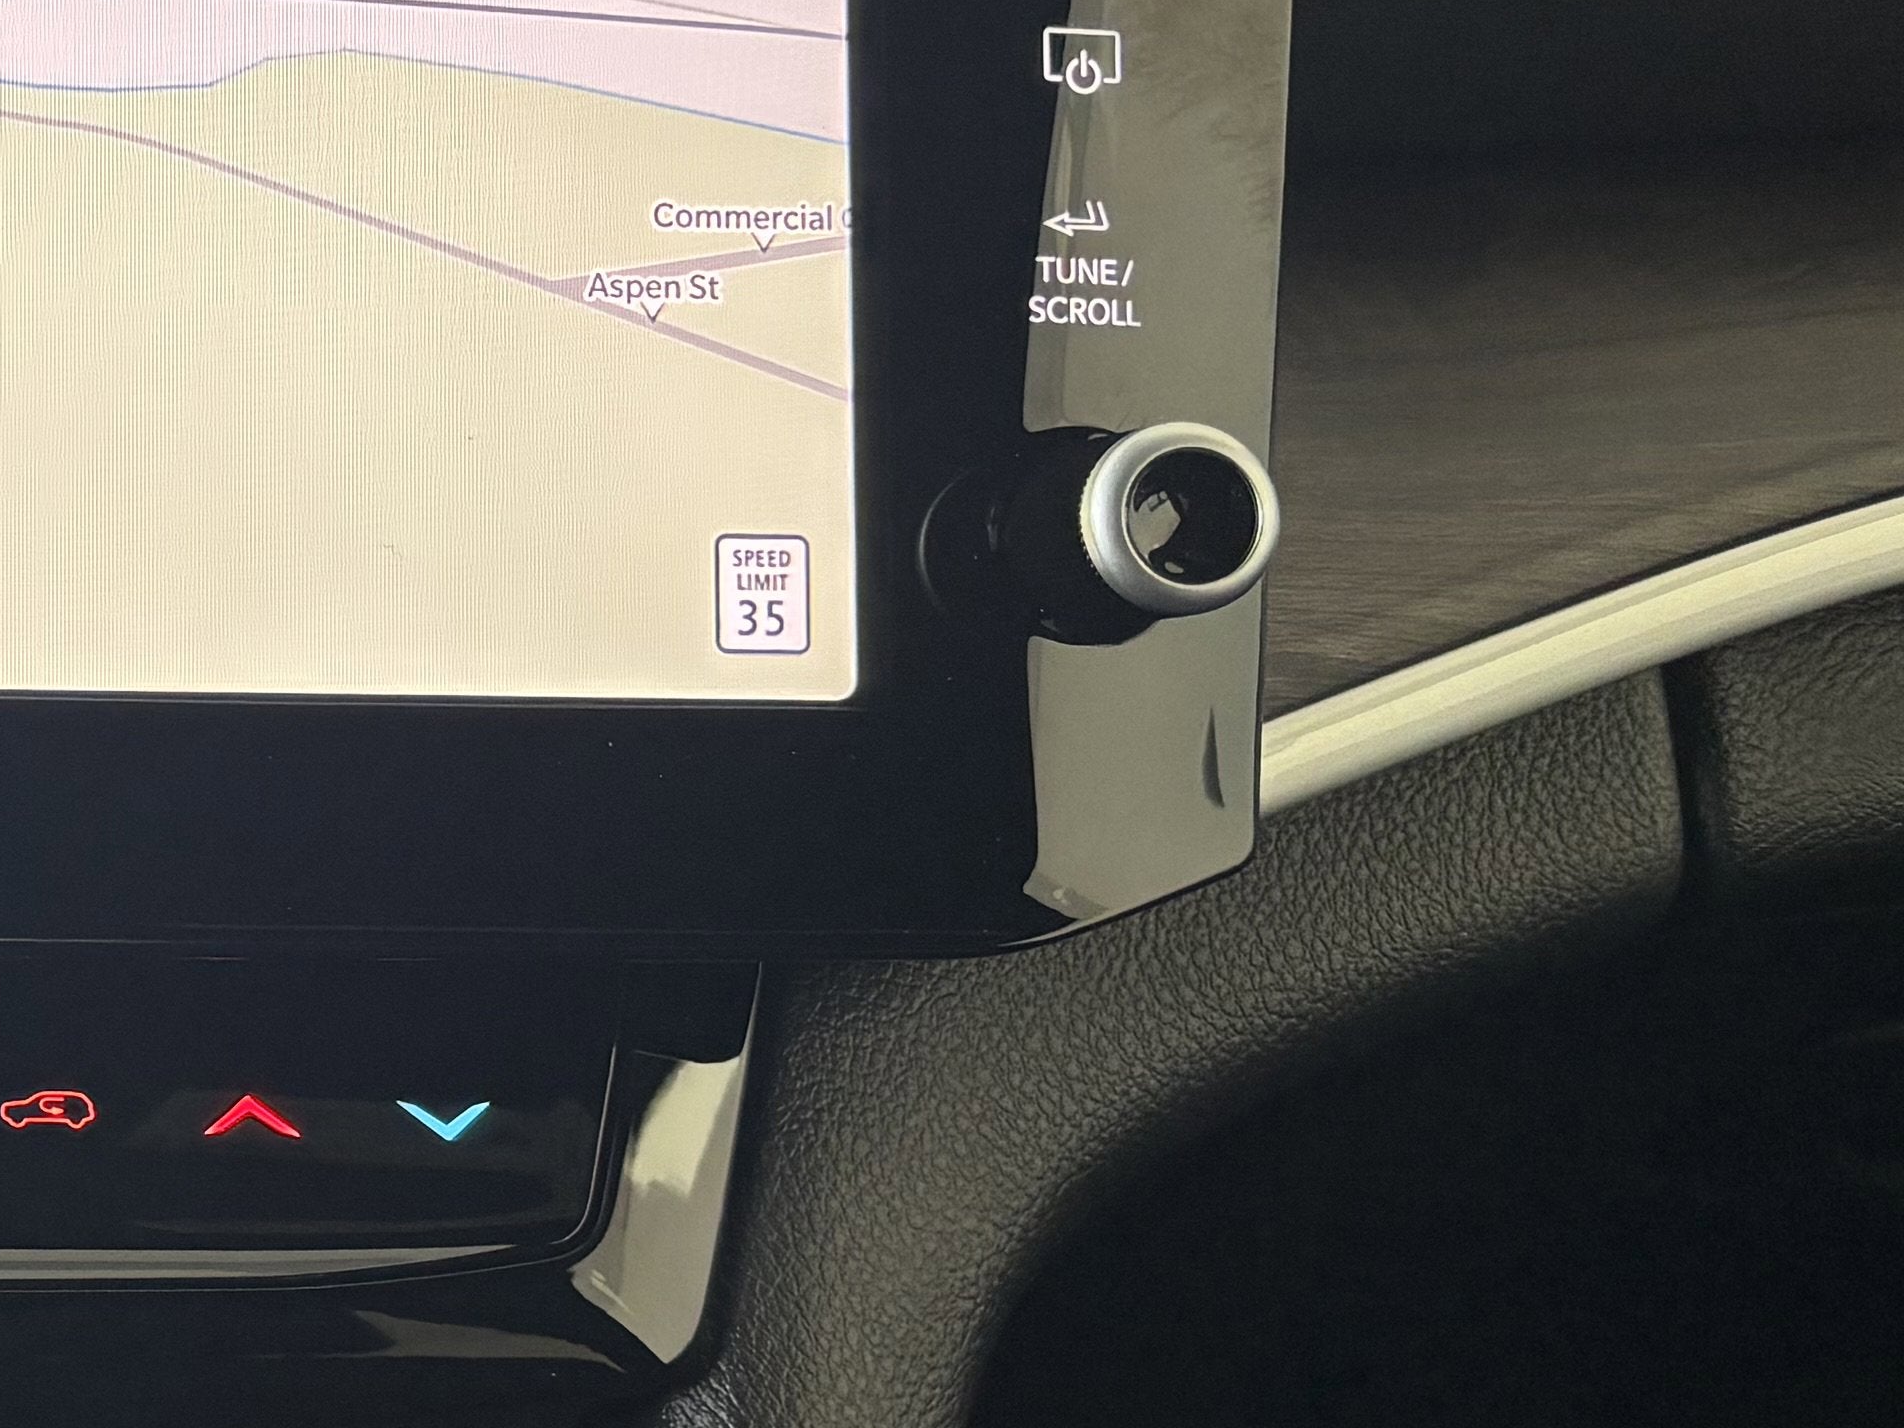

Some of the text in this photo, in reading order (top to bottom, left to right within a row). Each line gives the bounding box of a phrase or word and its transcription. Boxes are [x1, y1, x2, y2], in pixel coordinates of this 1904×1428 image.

[653, 201, 834, 232] Commercial
[587, 271, 720, 305] Aspen St
[1035, 255, 1135, 289] TUNE/
[1028, 296, 1142, 328] SCROLL
[731, 547, 792, 570] SPEED
[735, 572, 789, 594] LIMIT
[735, 600, 787, 639] 35
